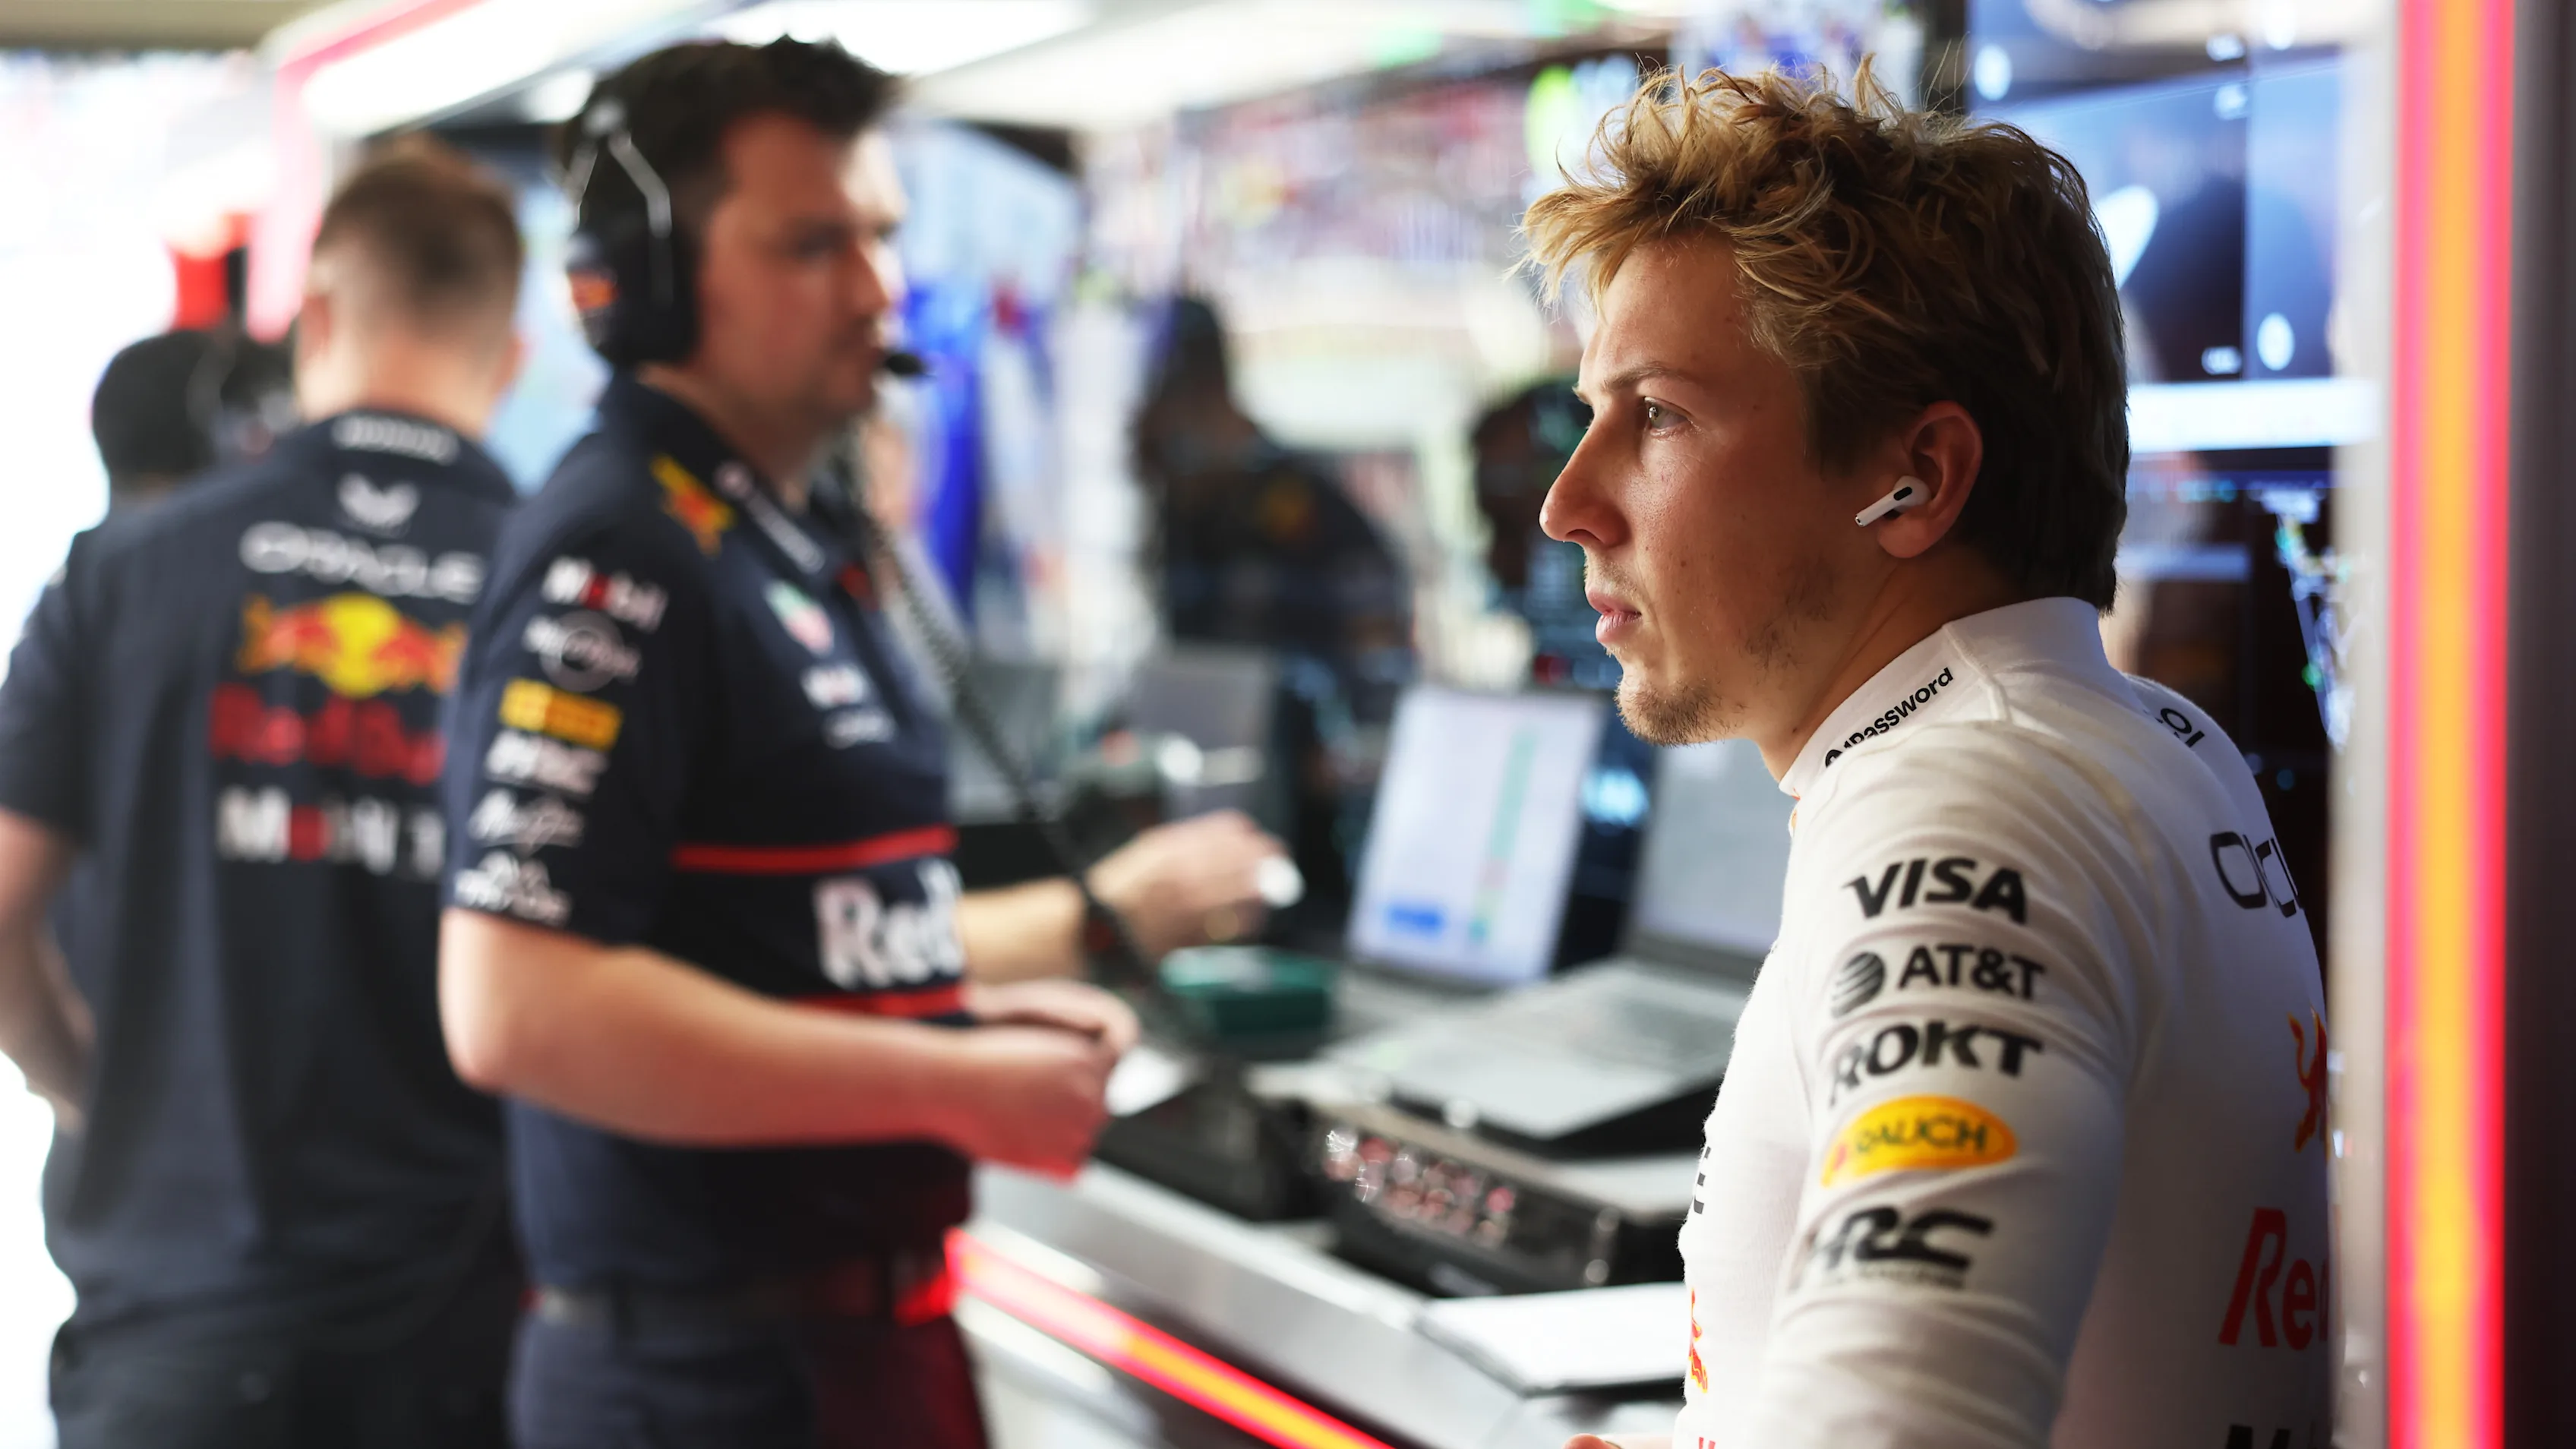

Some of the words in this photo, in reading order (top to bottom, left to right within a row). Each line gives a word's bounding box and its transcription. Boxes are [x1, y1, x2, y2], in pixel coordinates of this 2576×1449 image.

[1843, 856, 2027, 924] VISA
[1898, 943, 2046, 1000] AT&T
[1829, 1020, 2044, 1107] ROKT
